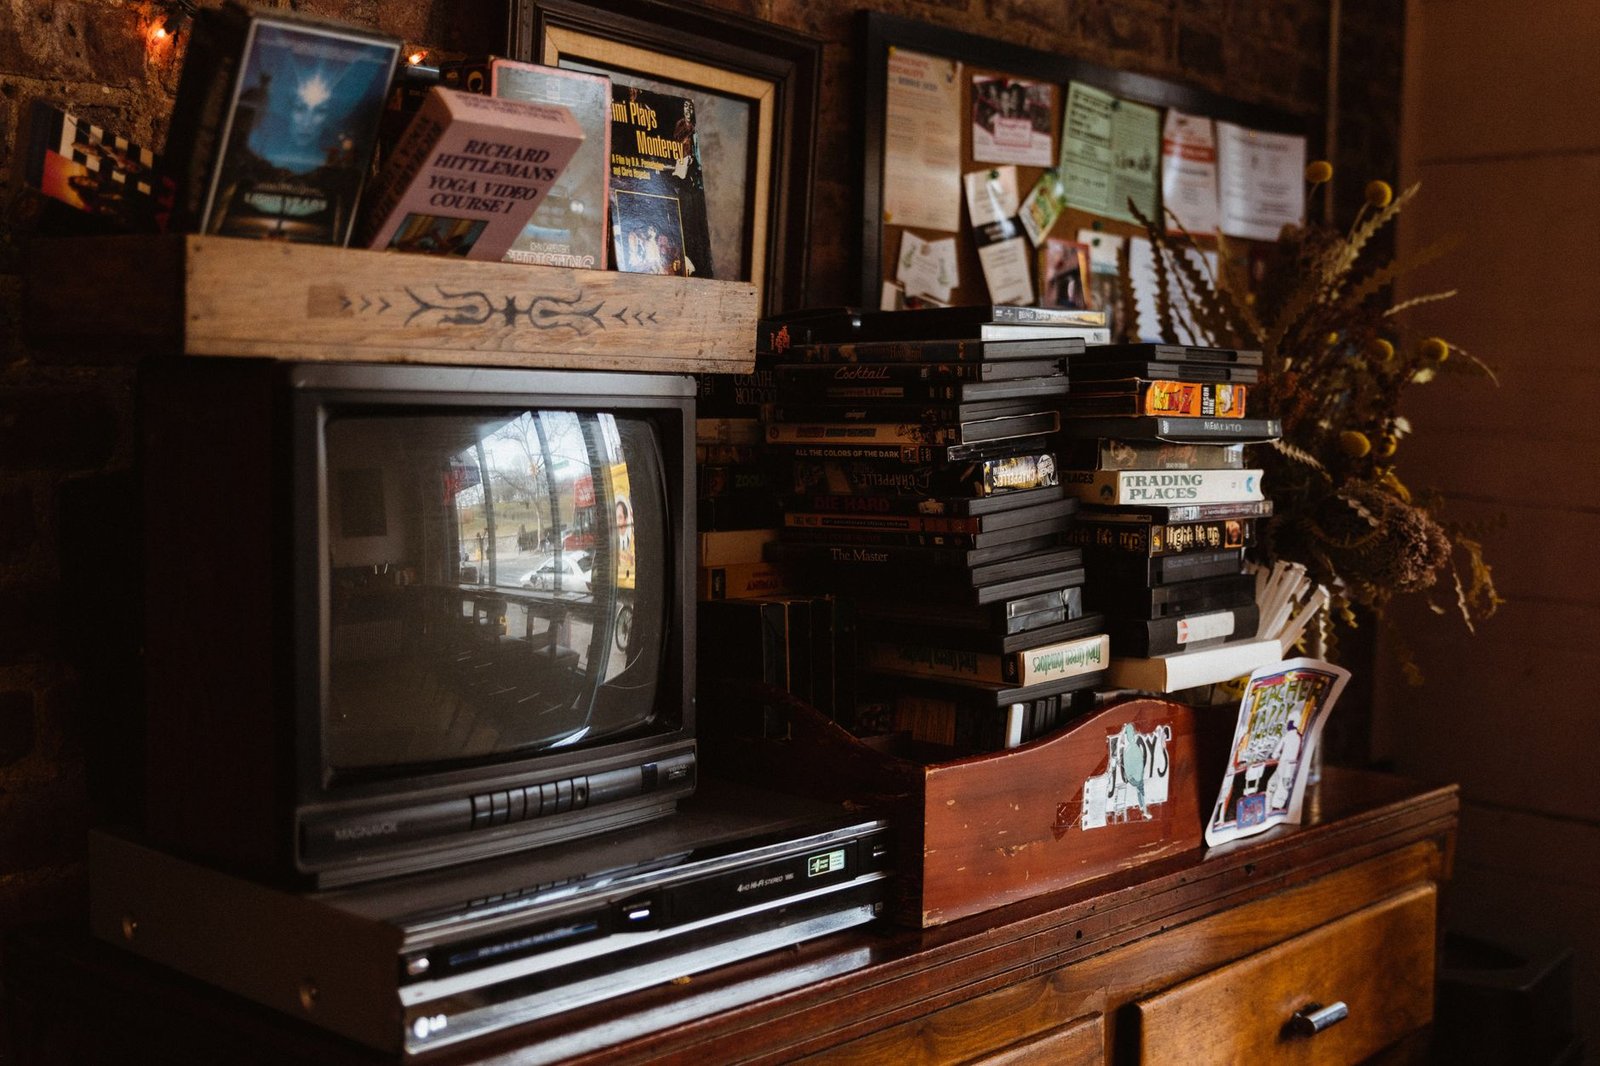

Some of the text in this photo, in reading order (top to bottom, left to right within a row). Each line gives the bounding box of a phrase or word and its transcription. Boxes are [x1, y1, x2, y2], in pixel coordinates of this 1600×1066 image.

[629, 101, 658, 131] Plays
[463, 139, 550, 164] RICHARD
[636, 130, 684, 165] Monterey
[428, 175, 538, 201] YOGA VIDEO
[430, 192, 503, 213] COURSE
[834, 365, 892, 380] Cocktail
[1202, 386, 1210, 415] SEASON
[809, 449, 823, 457] THE
[863, 450, 879, 458] THE
[879, 450, 900, 459] DARK
[1061, 472, 1094, 485] PLACES
[1122, 474, 1203, 487] TRADING
[845, 495, 891, 512] HARD
[1129, 486, 1198, 500] PLACES
[1166, 524, 1222, 553] light it up
[830, 547, 889, 562] The Master
[1032, 643, 1102, 675] Fried Green Tomatoes
